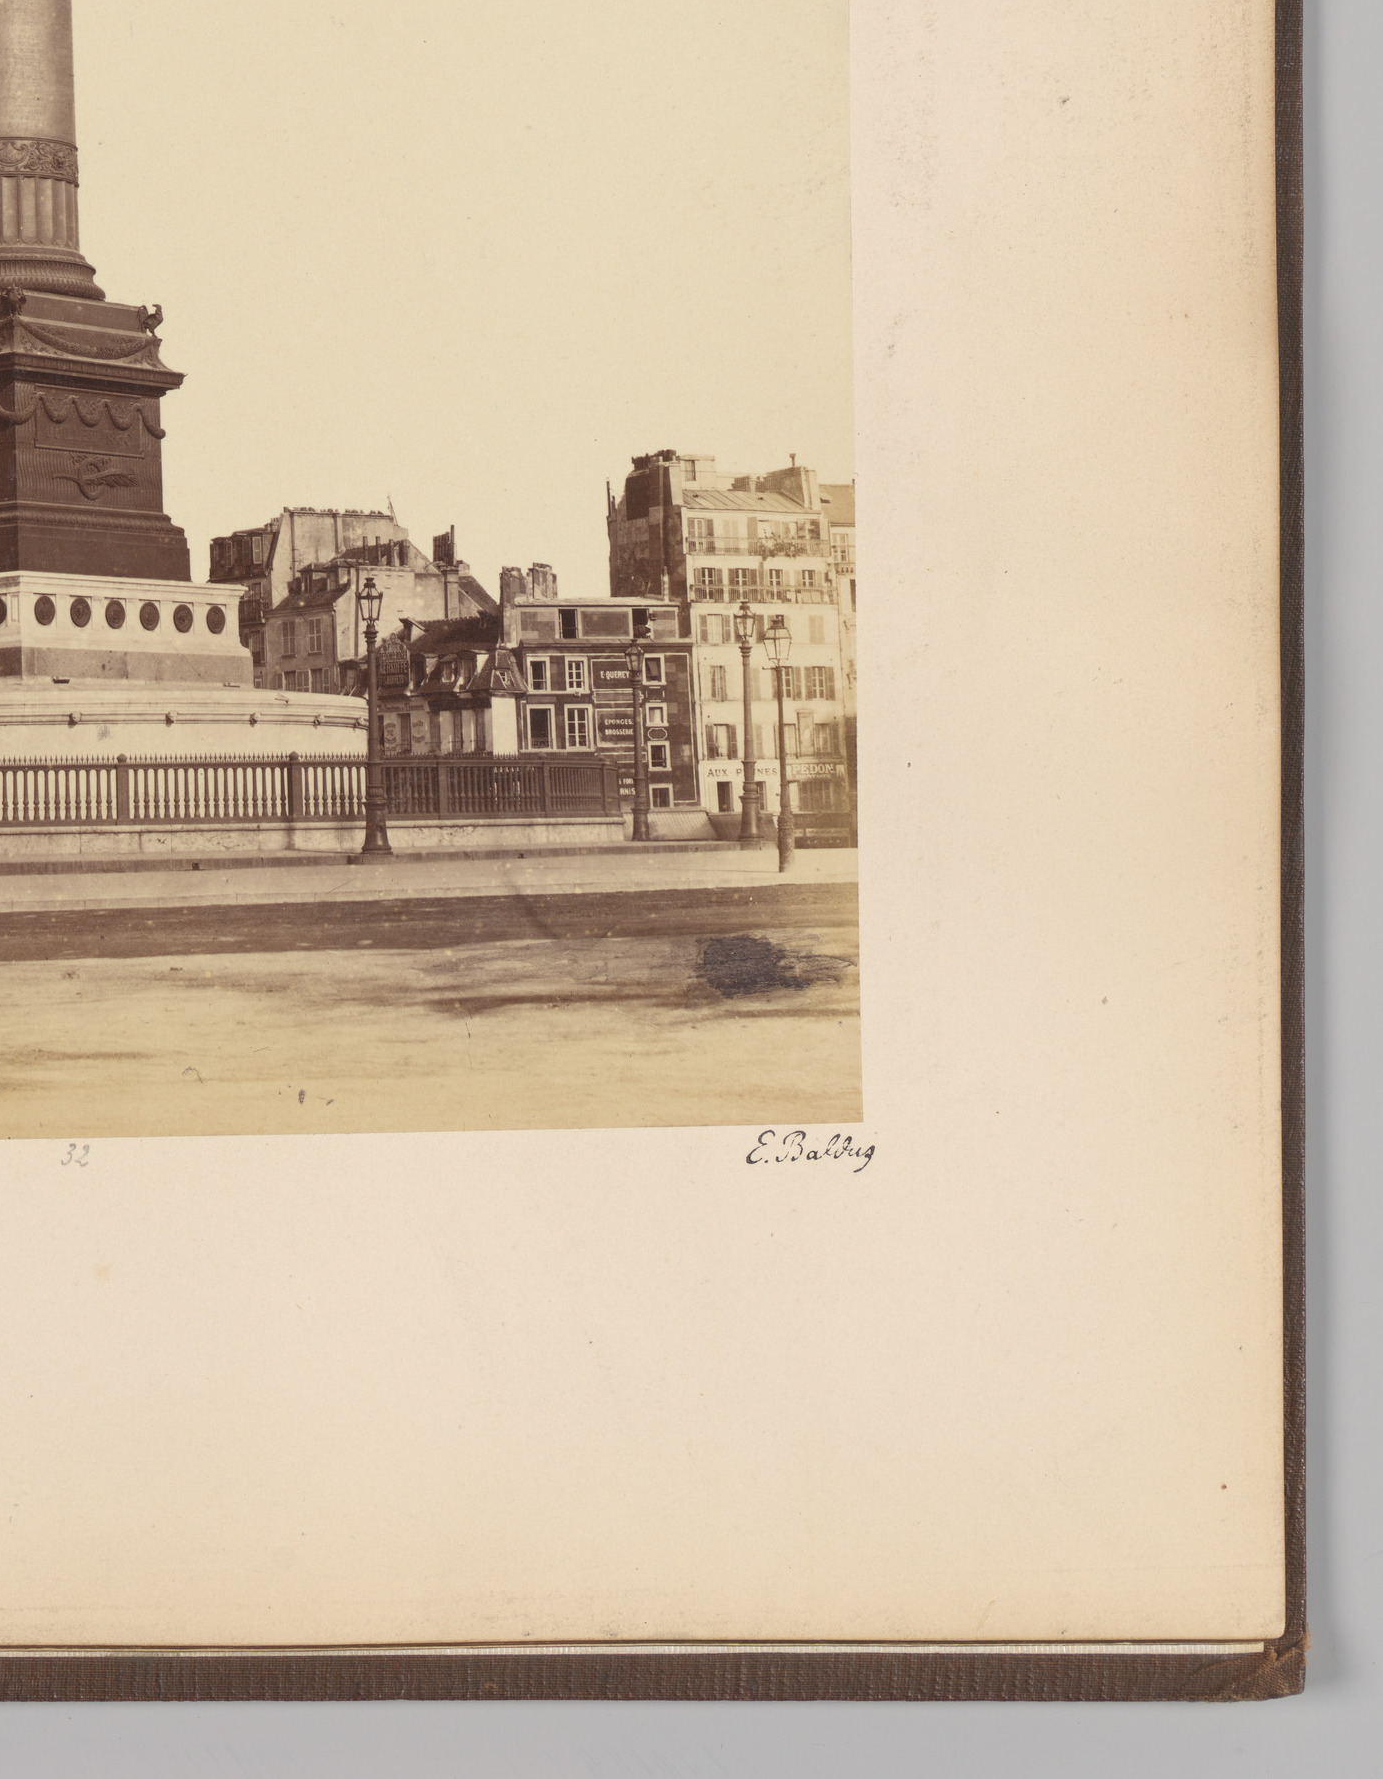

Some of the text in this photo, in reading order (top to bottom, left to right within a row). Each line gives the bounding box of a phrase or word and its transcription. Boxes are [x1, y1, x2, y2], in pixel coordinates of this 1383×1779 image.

[707, 768, 778, 778] AUX PNES
[61, 1142, 90, 1168] 32
